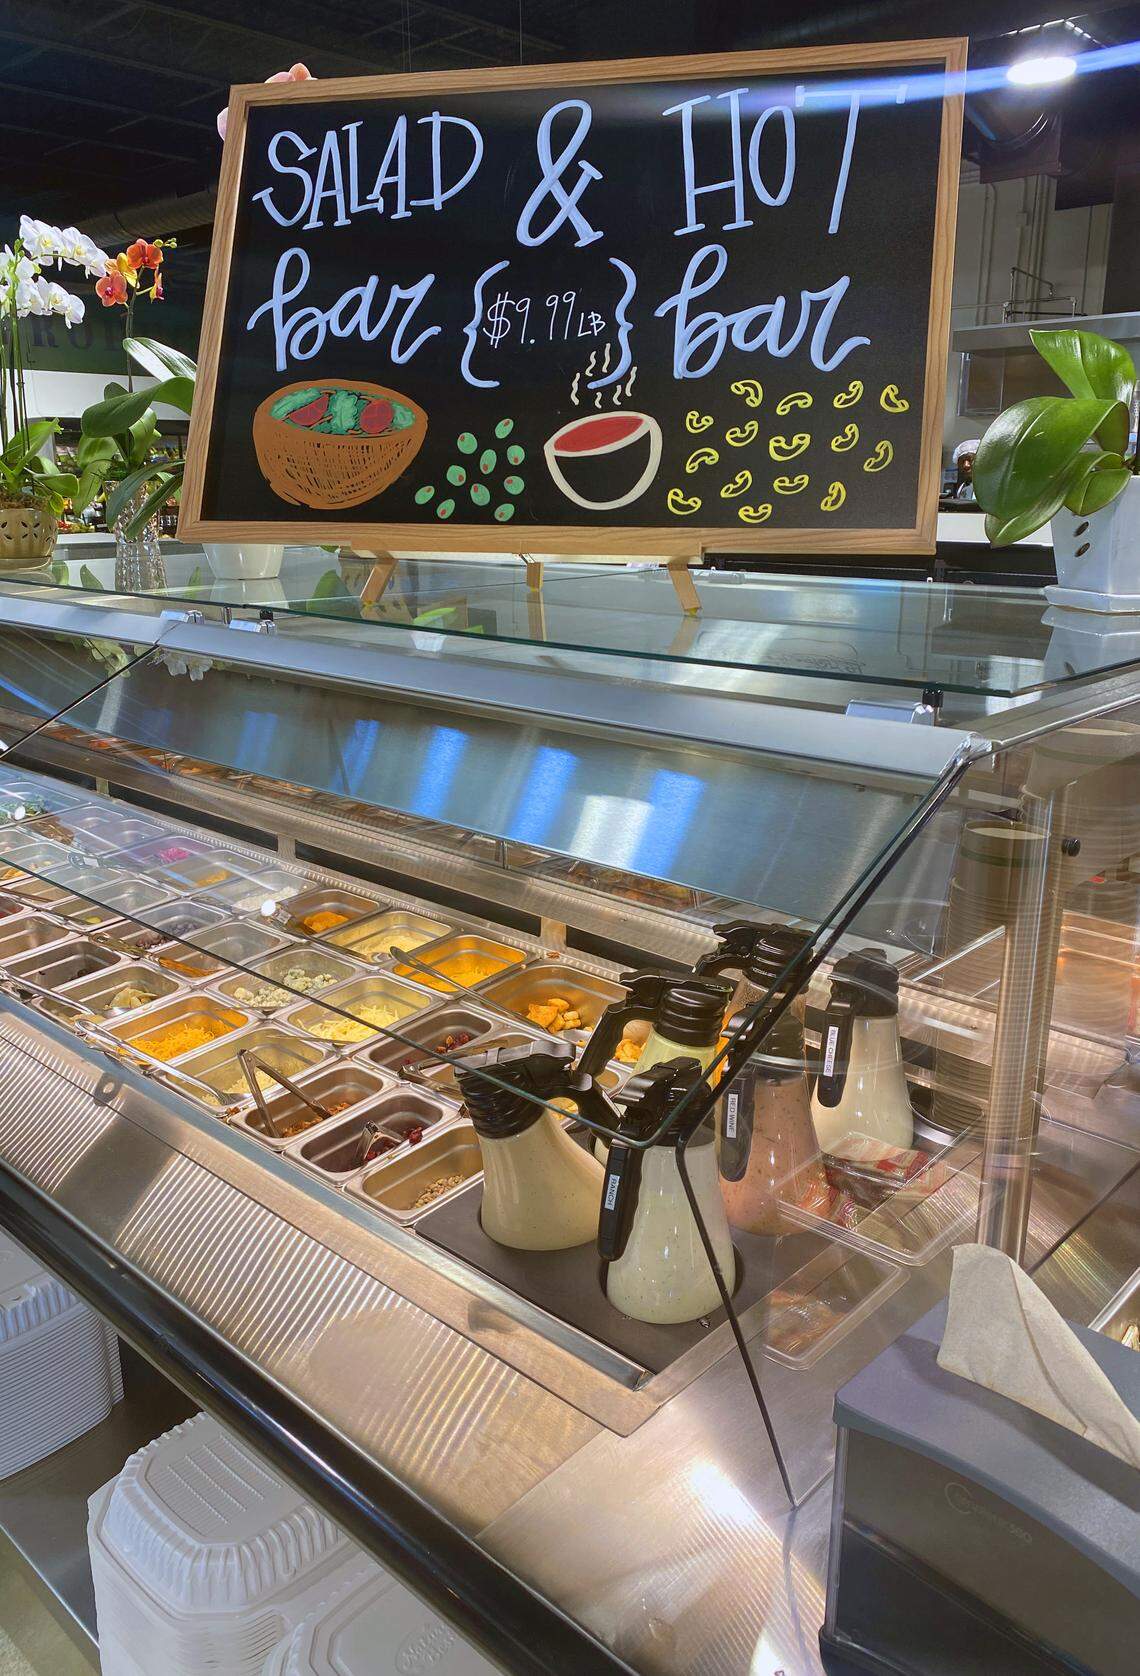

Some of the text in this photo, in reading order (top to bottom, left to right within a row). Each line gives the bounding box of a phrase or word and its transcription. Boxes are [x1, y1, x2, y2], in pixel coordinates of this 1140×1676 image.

[252, 86, 908, 247] SALAD & HOT
[246, 247, 441, 371] bar
[654, 244, 871, 379] bar
[728, 1097, 737, 1134] RED WINE
[607, 1177, 618, 1208] RANCH
